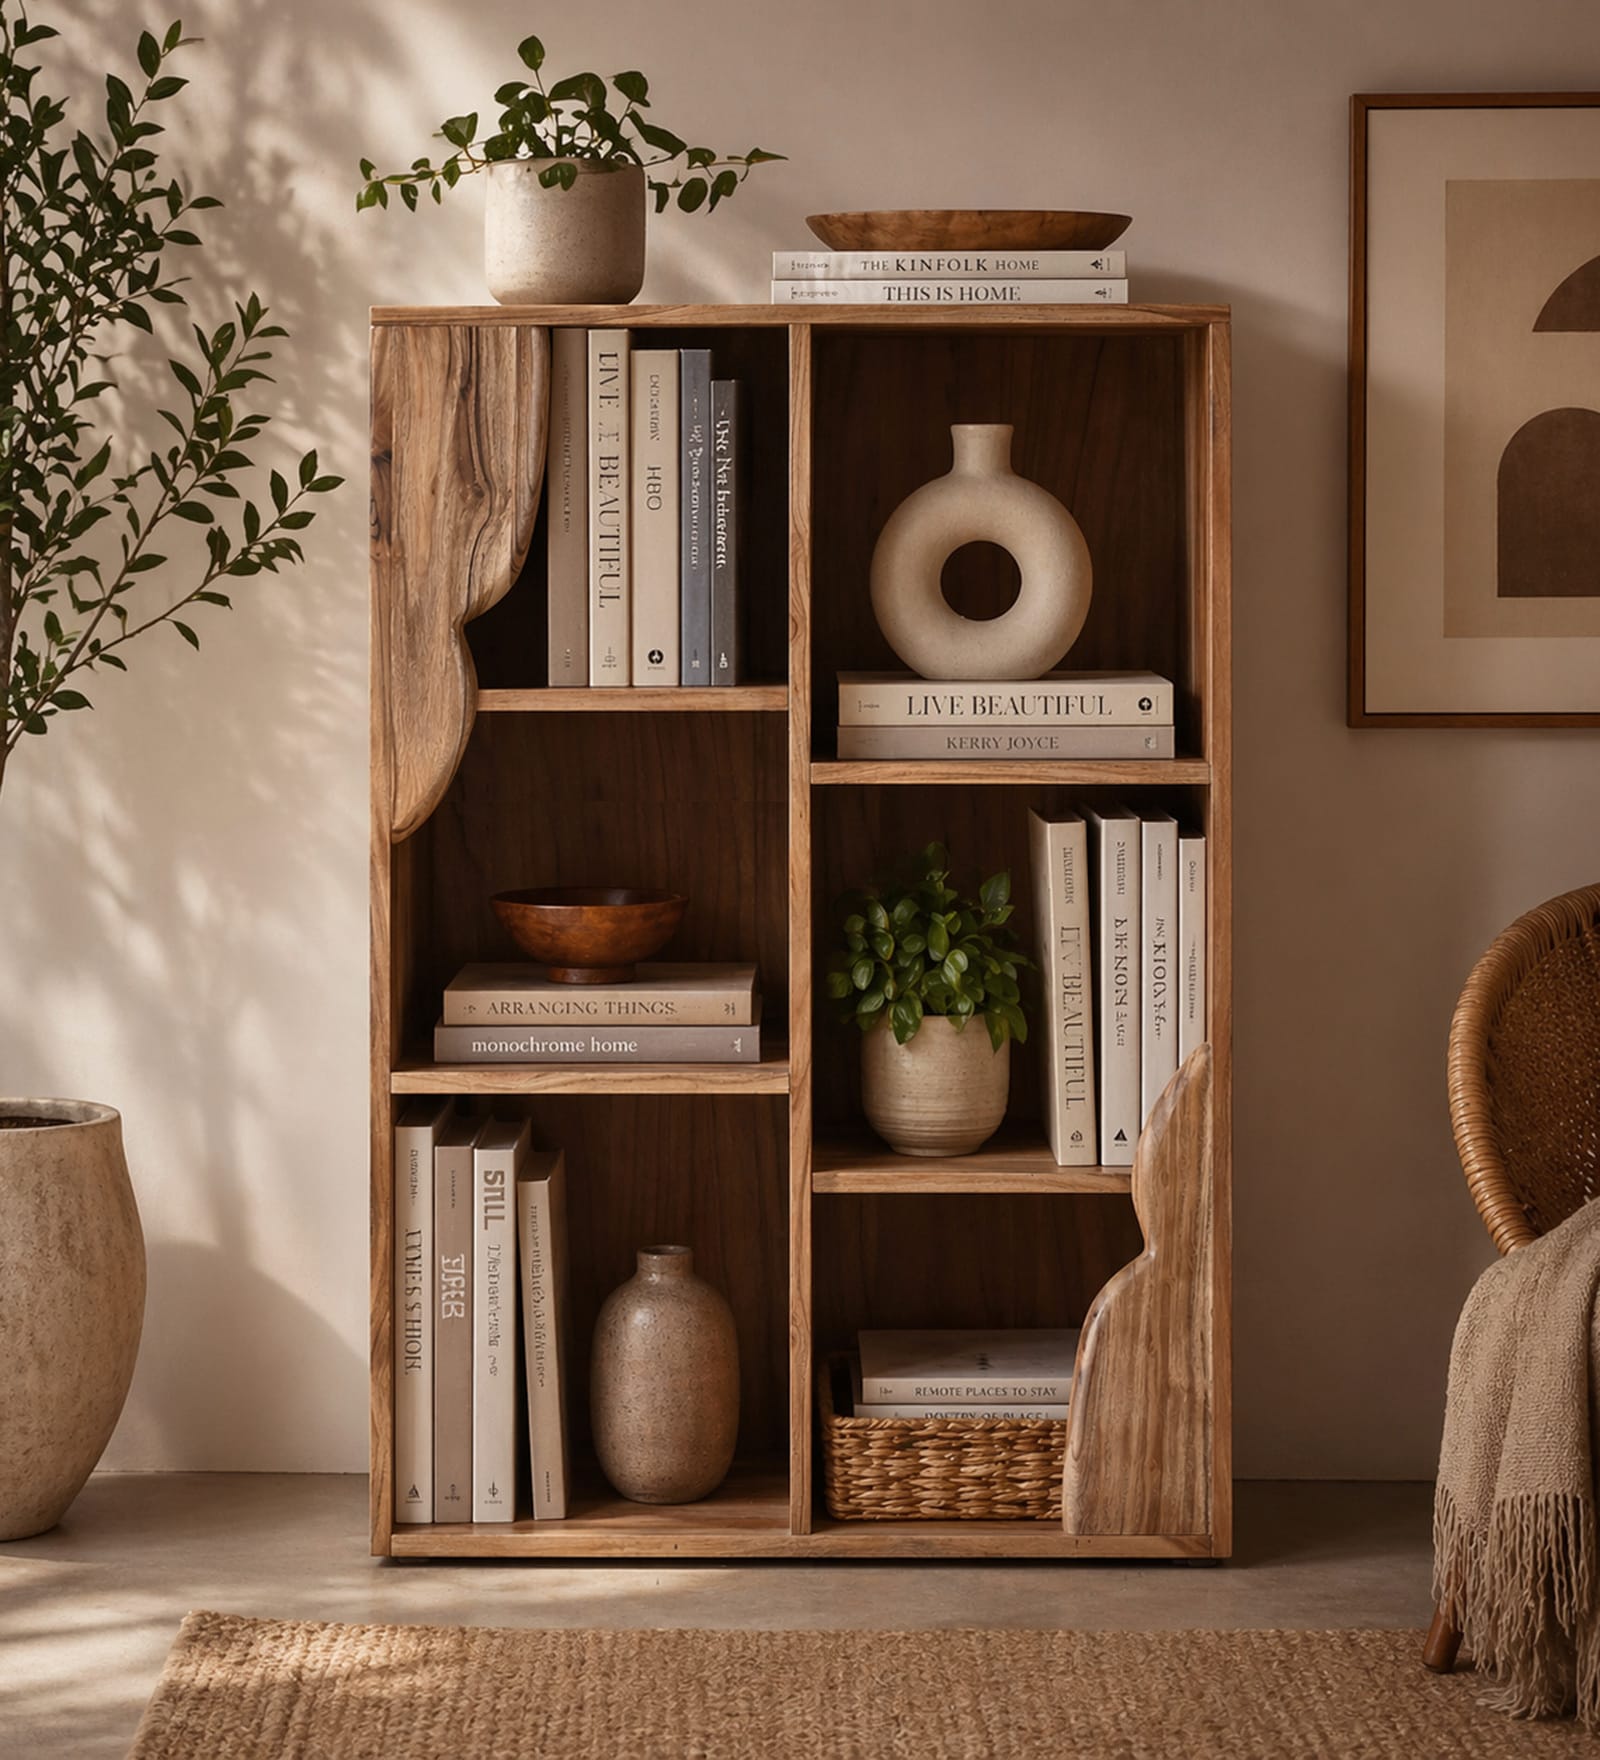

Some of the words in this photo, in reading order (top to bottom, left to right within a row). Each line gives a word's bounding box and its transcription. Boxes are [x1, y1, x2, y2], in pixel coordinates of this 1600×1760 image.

[861, 260, 889, 271] THE
[895, 258, 988, 272] KINFOLK
[995, 260, 1040, 271] HOME
[883, 286, 930, 302] THIS
[937, 286, 953, 302] IS
[959, 286, 1021, 302] HOME
[598, 455, 620, 609] BEAUTIFUL
[907, 695, 964, 716] LIVE
[972, 695, 1113, 716] BEAUTIFUL
[946, 736, 1003, 751] KERRY
[1006, 736, 1060, 752] JOYCE
[486, 1001, 598, 1016] ARRANGING
[604, 1001, 676, 1016] THINGS
[471, 1036, 585, 1053] monochrome
[590, 1036, 638, 1053] home
[1062, 972, 1086, 1111] BEAUTIFUL
[915, 1387, 961, 1397] REMOTE
[966, 1387, 1008, 1397] PLACES
[1013, 1387, 1026, 1397] TO
[1030, 1387, 1057, 1397] STAY
